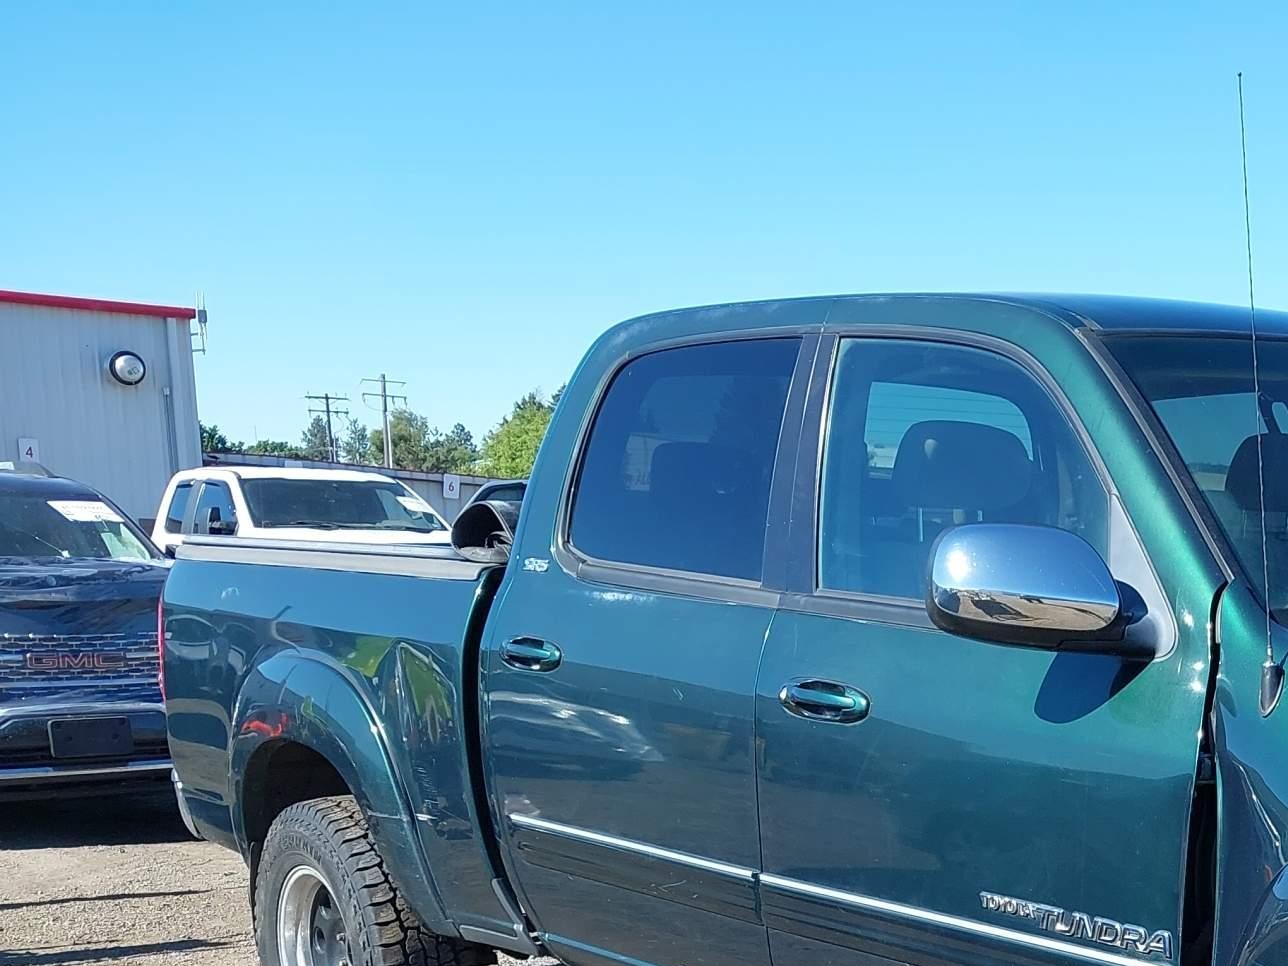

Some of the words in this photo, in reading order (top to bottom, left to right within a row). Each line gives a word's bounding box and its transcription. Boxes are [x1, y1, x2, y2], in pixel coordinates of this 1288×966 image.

[25, 445, 34, 459] 4
[448, 480, 455, 492] 6
[26, 651, 125, 669] GMC
[979, 891, 1038, 920] TOYOTA
[1037, 903, 1174, 959] TUNDRA
